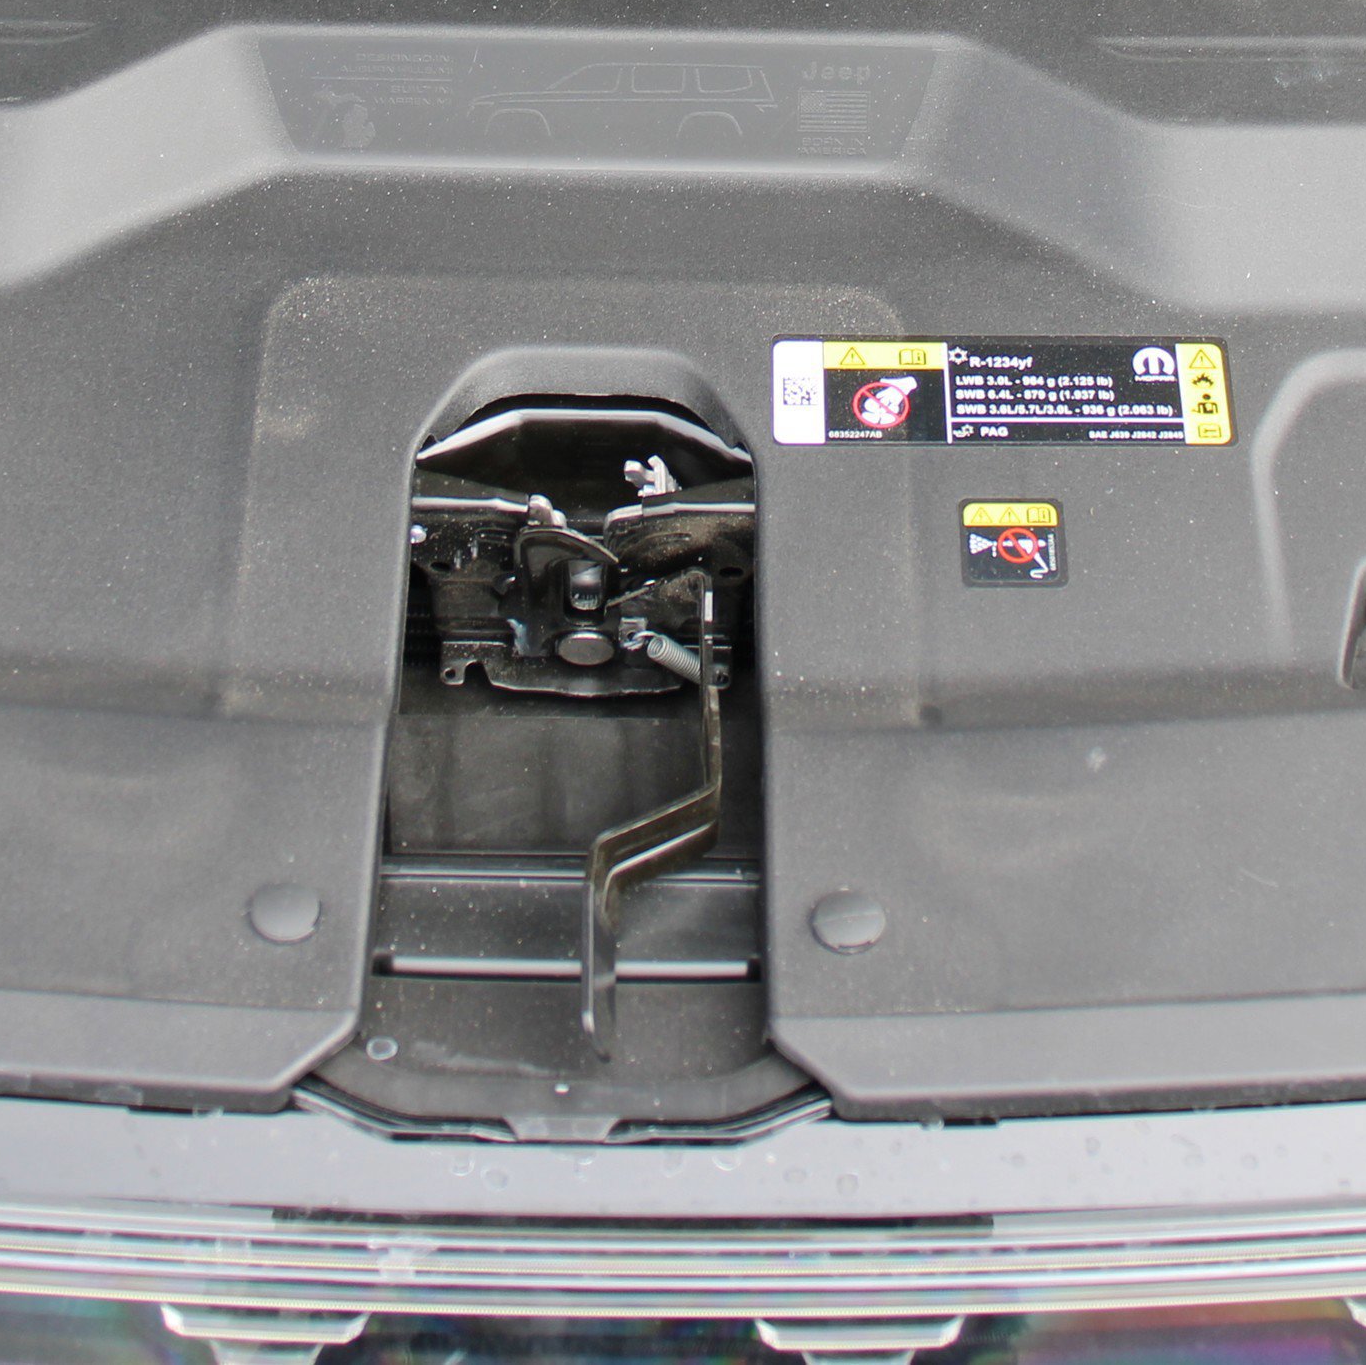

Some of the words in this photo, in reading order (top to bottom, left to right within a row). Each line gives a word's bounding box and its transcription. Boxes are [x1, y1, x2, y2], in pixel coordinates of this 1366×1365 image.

[801, 62, 871, 84] Jeep
[800, 146, 867, 155] AMERICA
[969, 356, 1033, 370] R-1234yf
[955, 376, 984, 386] LWB
[986, 376, 1013, 386] 3.0L
[1058, 376, 1094, 388] (2.125
[1097, 376, 1113, 388] lb)
[955, 389, 985, 400] SWB
[1098, 389, 1115, 402] lb)
[956, 404, 987, 415] SWB
[1156, 404, 1173, 417] lb)
[980, 426, 1009, 437] PAG
